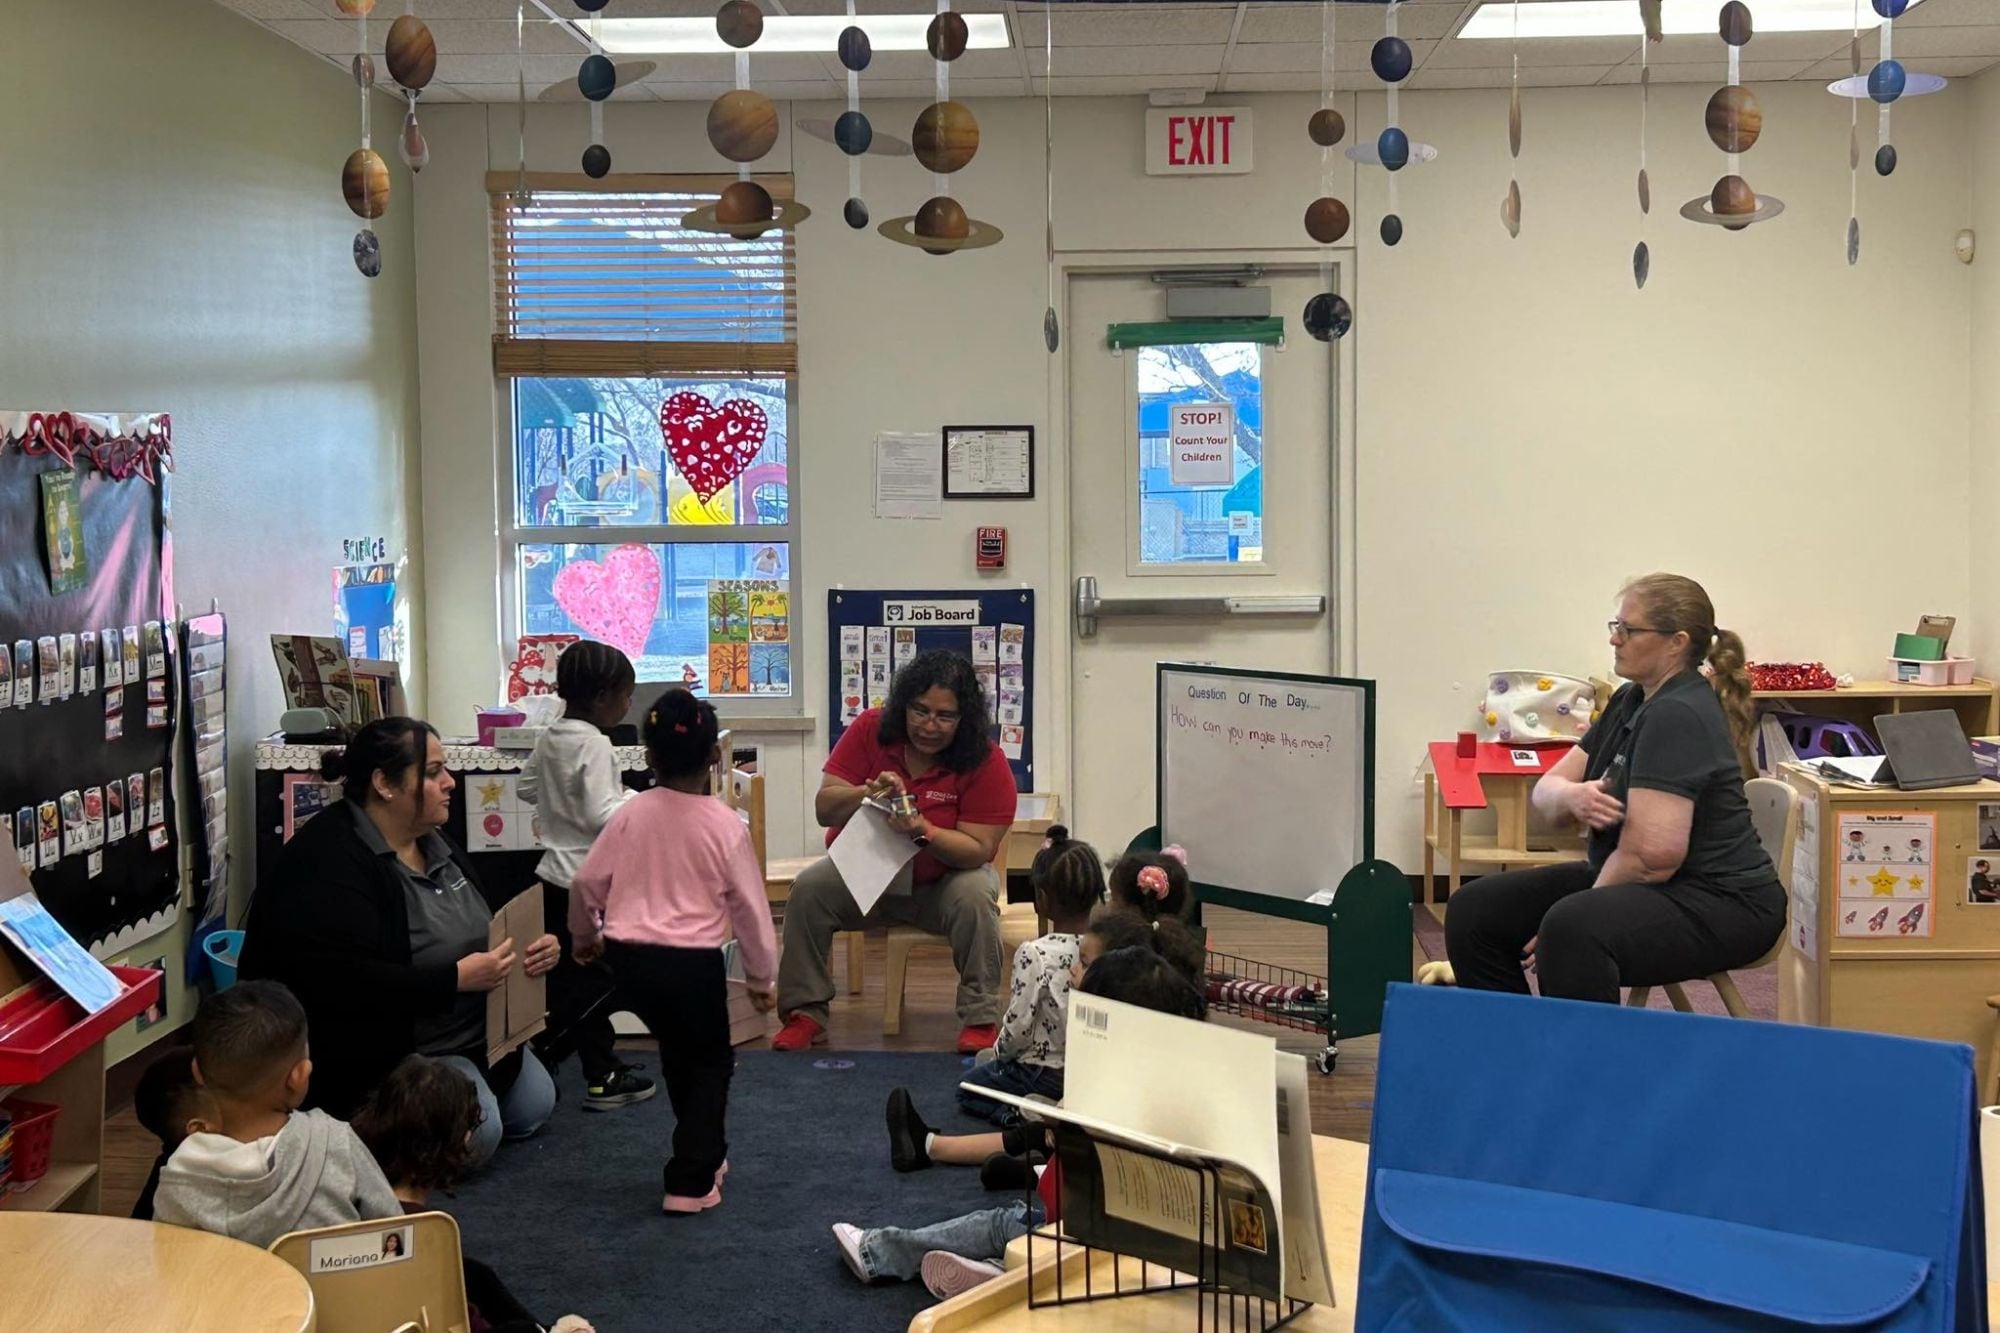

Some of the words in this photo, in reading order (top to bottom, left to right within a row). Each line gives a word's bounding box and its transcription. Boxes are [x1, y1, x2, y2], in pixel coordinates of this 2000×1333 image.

[1168, 115, 1236, 166] EXIT
[1180, 412, 1222, 425] STOP!
[1175, 436, 1204, 446] Count
[1206, 436, 1228, 446] Your
[1181, 452, 1222, 462] Children
[979, 529, 1003, 538] FIRE
[343, 536, 386, 562] SCIENCE
[718, 580, 779, 592] SEASONS
[907, 608, 932, 621] Job
[935, 608, 975, 620] Board
[1188, 685, 1227, 700] Question
[1238, 692, 1250, 705] Of
[1258, 694, 1278, 708] The
[1203, 720, 1221, 734] can
[1227, 726, 1244, 744] you
[1249, 730, 1276, 744] make
[1301, 734, 1332, 752] move?
